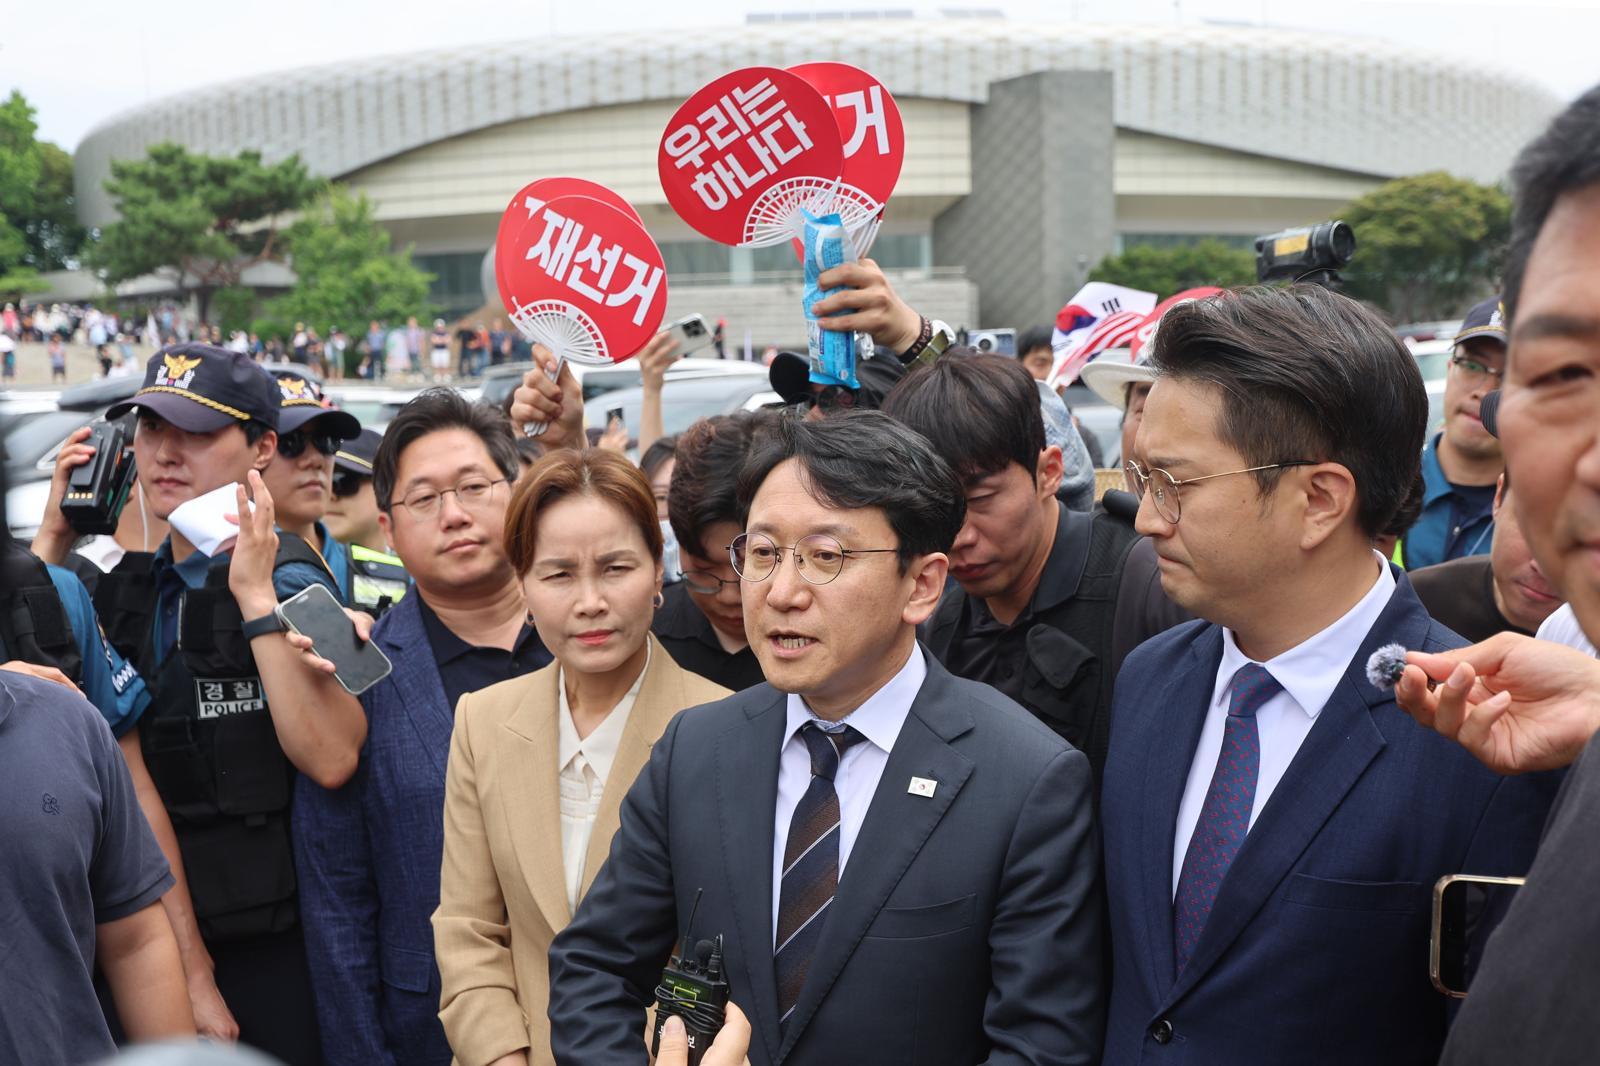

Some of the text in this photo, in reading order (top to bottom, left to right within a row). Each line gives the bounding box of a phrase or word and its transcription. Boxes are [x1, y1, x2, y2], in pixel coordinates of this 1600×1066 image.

[665, 77, 787, 169] 우리는
[690, 110, 814, 211] 하나다
[823, 85, 890, 159] 거
[525, 208, 664, 327] 재선거
[204, 701, 261, 715] POLICE
